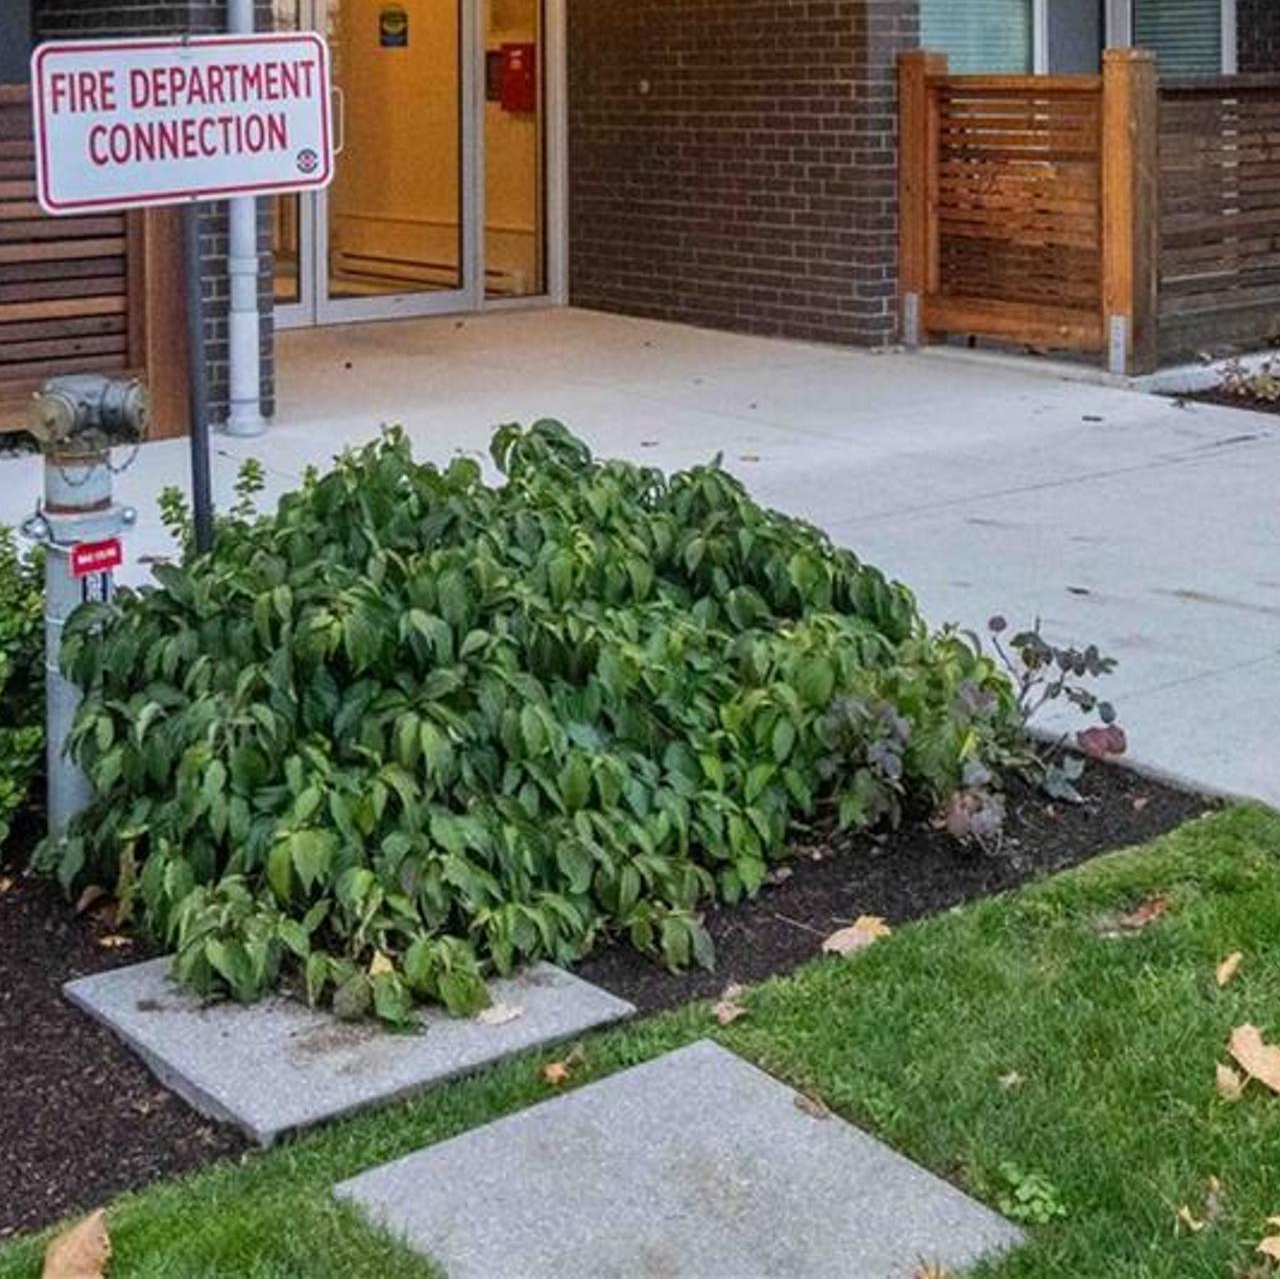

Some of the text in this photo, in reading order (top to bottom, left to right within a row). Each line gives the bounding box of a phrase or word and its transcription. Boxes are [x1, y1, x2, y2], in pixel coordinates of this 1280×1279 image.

[51, 60, 315, 114] FIRE DEPARTMENT
[89, 114, 288, 166] CONNECTION
